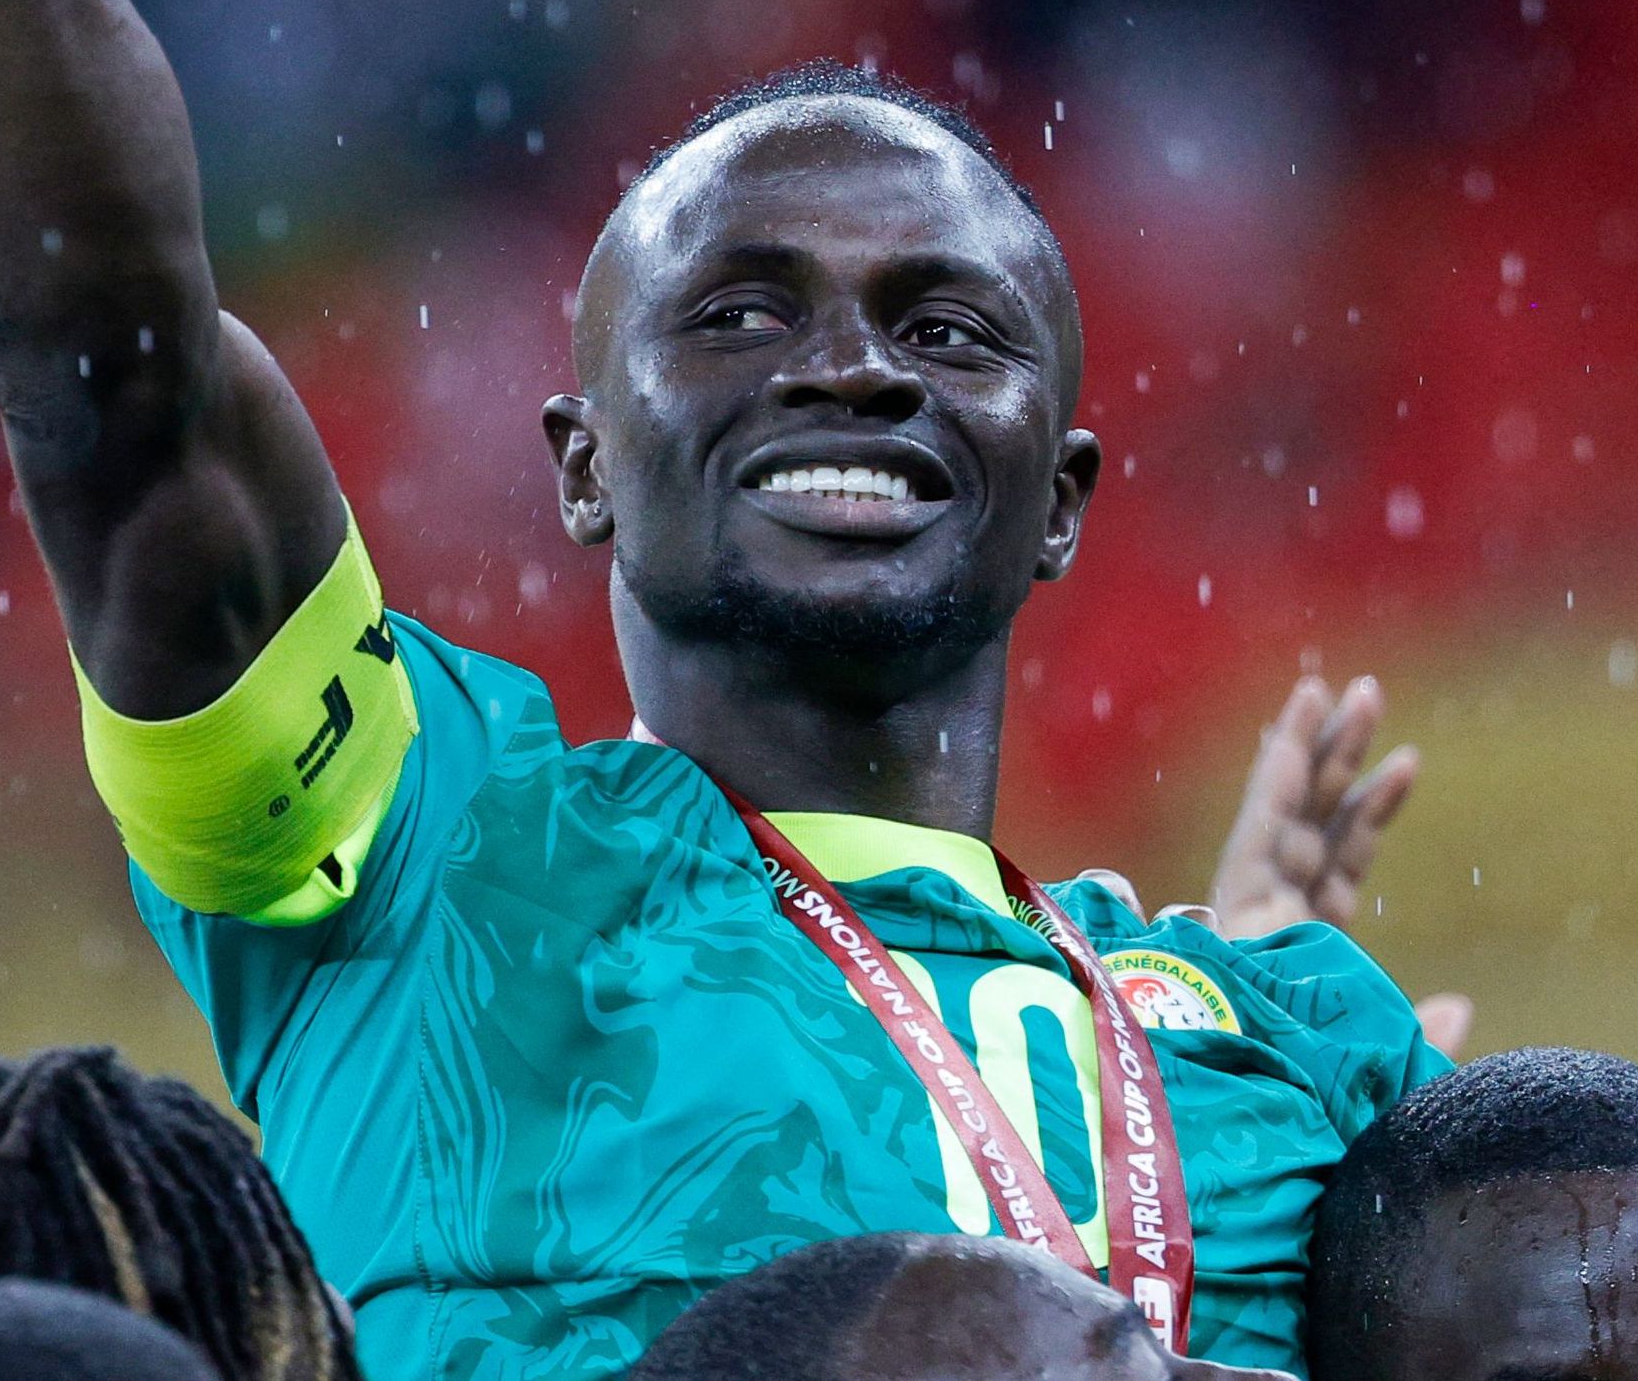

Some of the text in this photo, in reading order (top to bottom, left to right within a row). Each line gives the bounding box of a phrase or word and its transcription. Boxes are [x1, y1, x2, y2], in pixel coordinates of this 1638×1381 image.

[793, 890, 913, 1016] NATIONS
[903, 1020, 945, 1064] OF
[1114, 1033, 1144, 1081] OF
[937, 1068, 988, 1133] CUP
[1123, 1080, 1156, 1147] CUP
[1127, 1152, 1166, 1270] AFRICA
